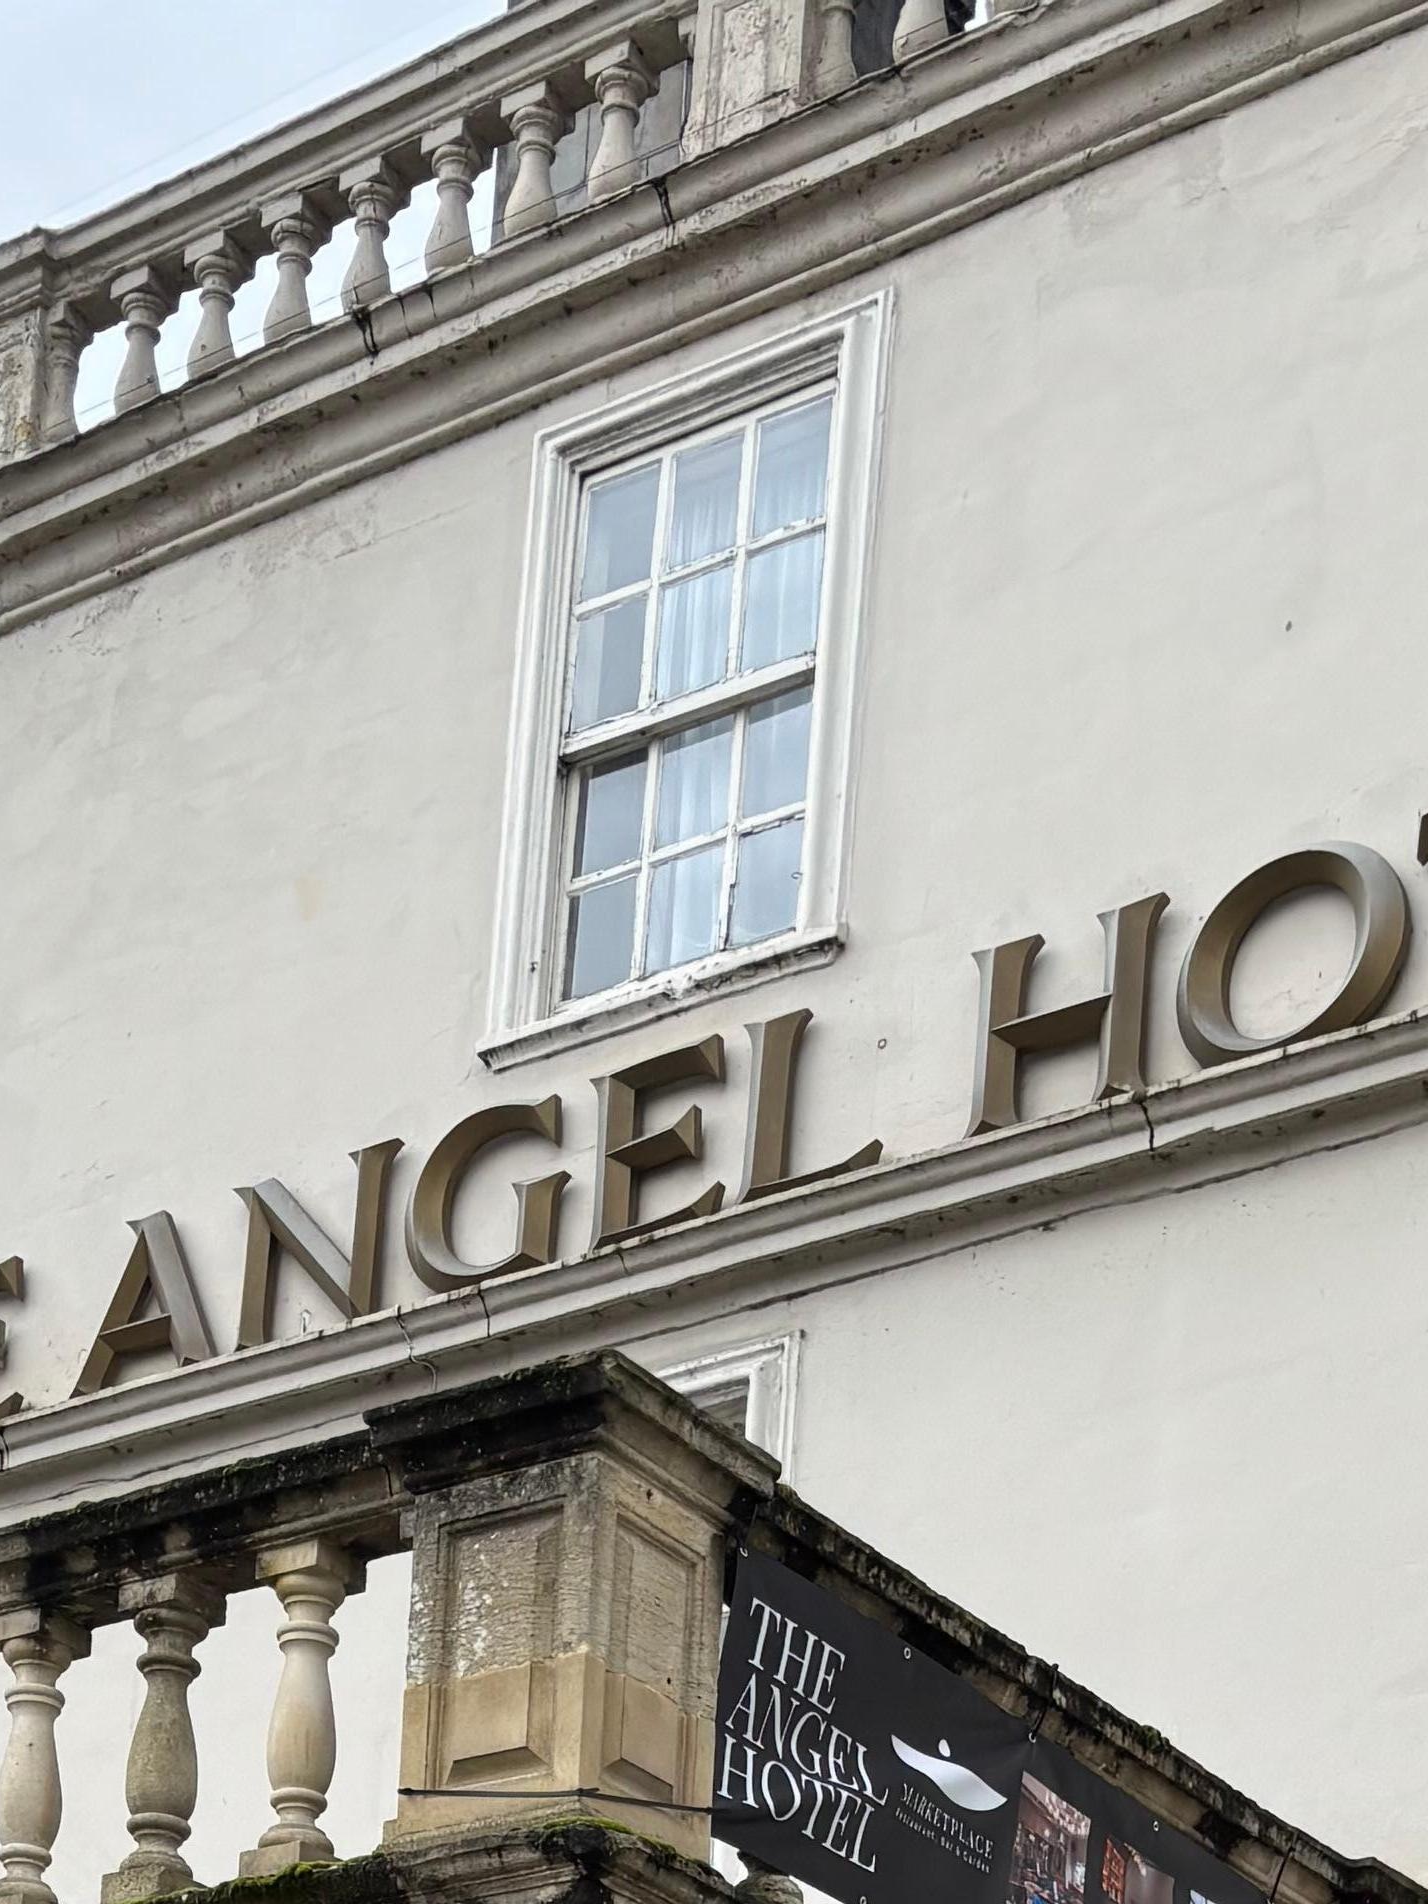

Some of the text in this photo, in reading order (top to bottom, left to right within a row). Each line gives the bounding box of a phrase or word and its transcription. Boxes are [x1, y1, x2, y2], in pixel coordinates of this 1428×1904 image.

[70, 1008, 884, 1398] ANGEL
[748, 1597, 845, 1714] THE
[717, 1733, 876, 1872] HOTEL
[725, 1673, 888, 1806] ANGEL
[901, 1783, 993, 1859] MARKETPLACE
